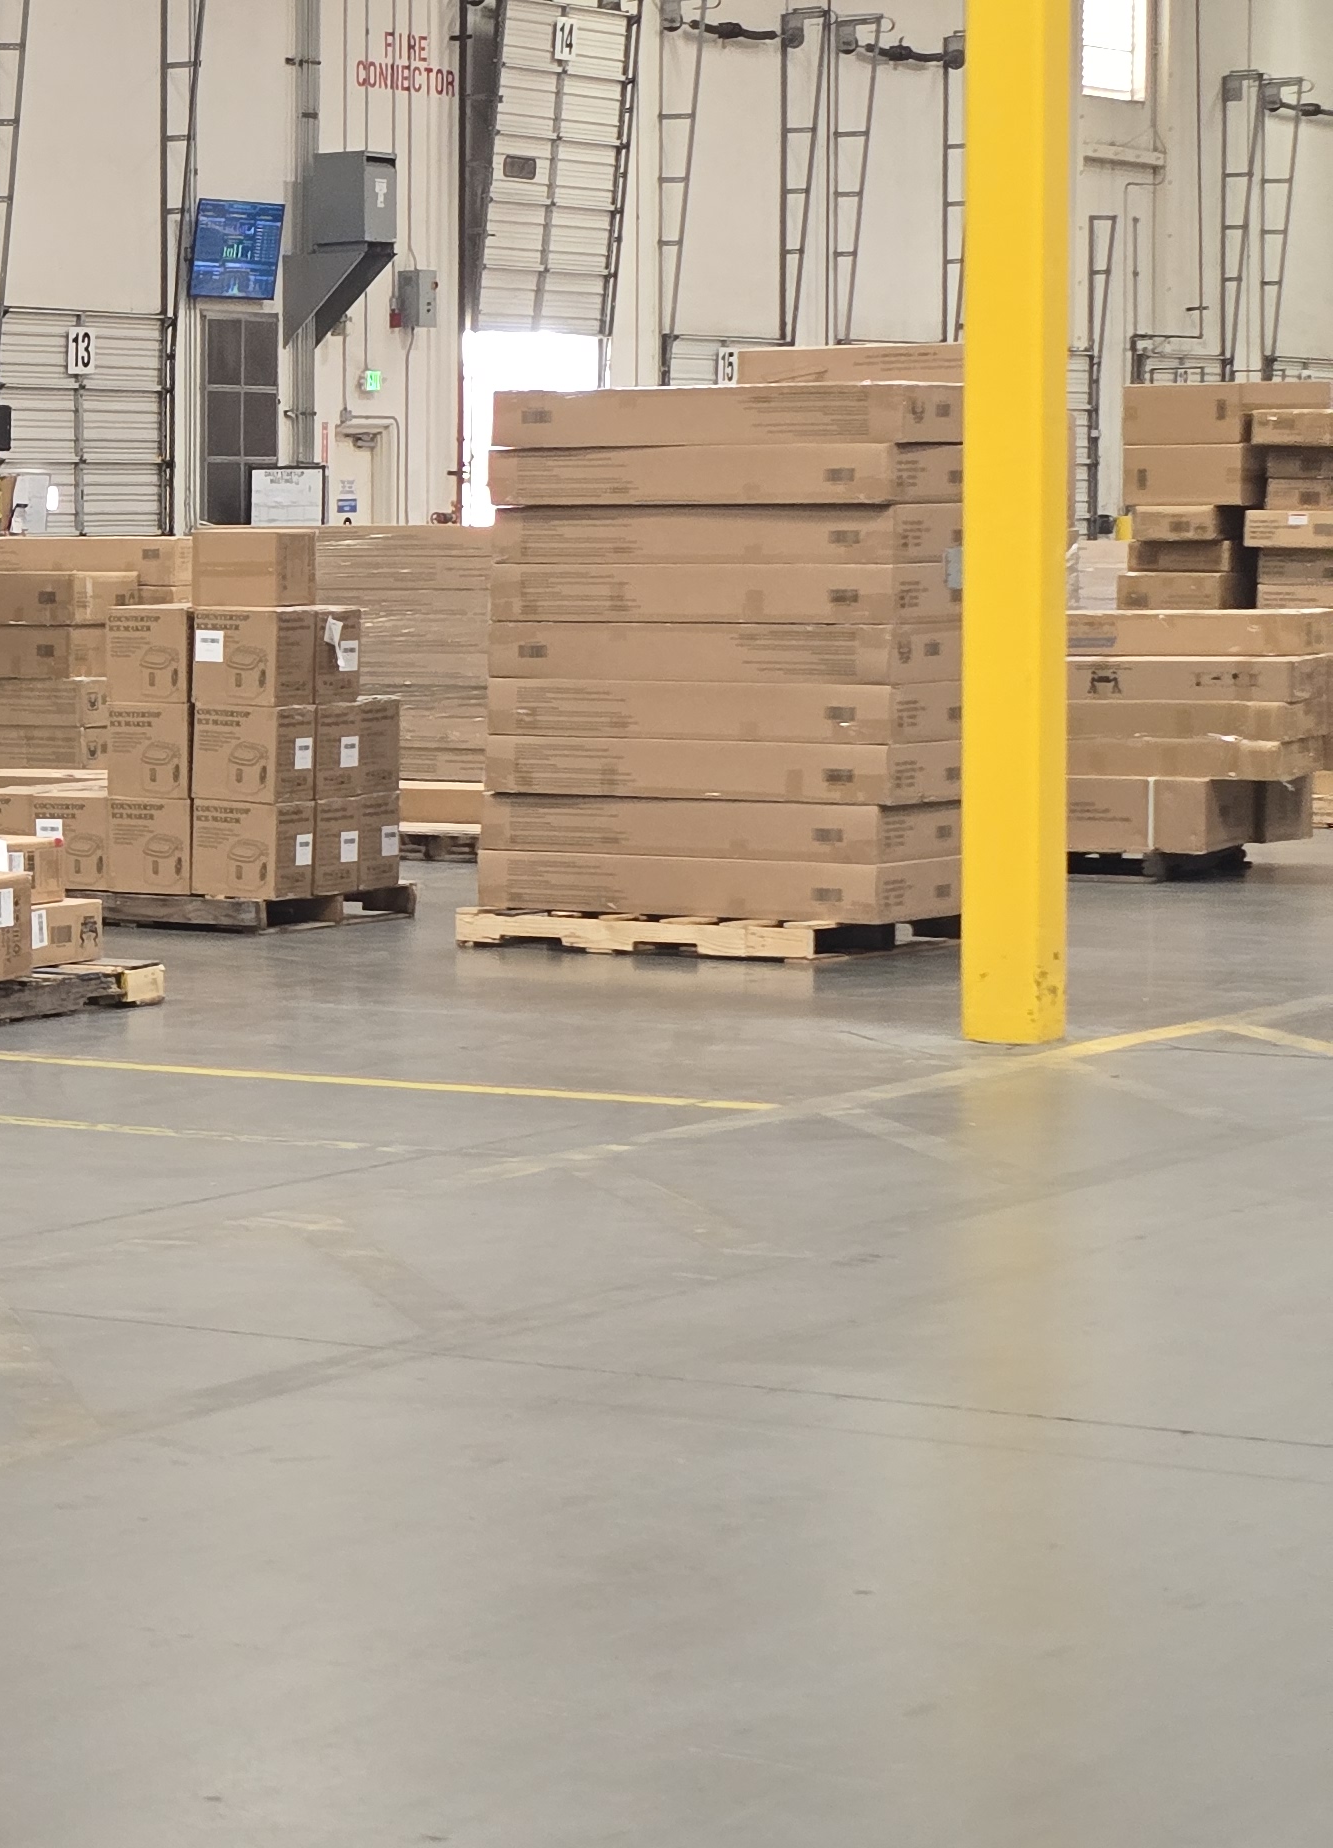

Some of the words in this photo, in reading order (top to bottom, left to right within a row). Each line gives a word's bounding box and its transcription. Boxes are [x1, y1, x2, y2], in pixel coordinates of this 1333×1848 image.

[384, 31, 427, 63] FIRE
[559, 22, 573, 55] 14
[356, 60, 455, 97] CONNECTOR
[71, 331, 91, 369] 13
[720, 352, 735, 383] 15
